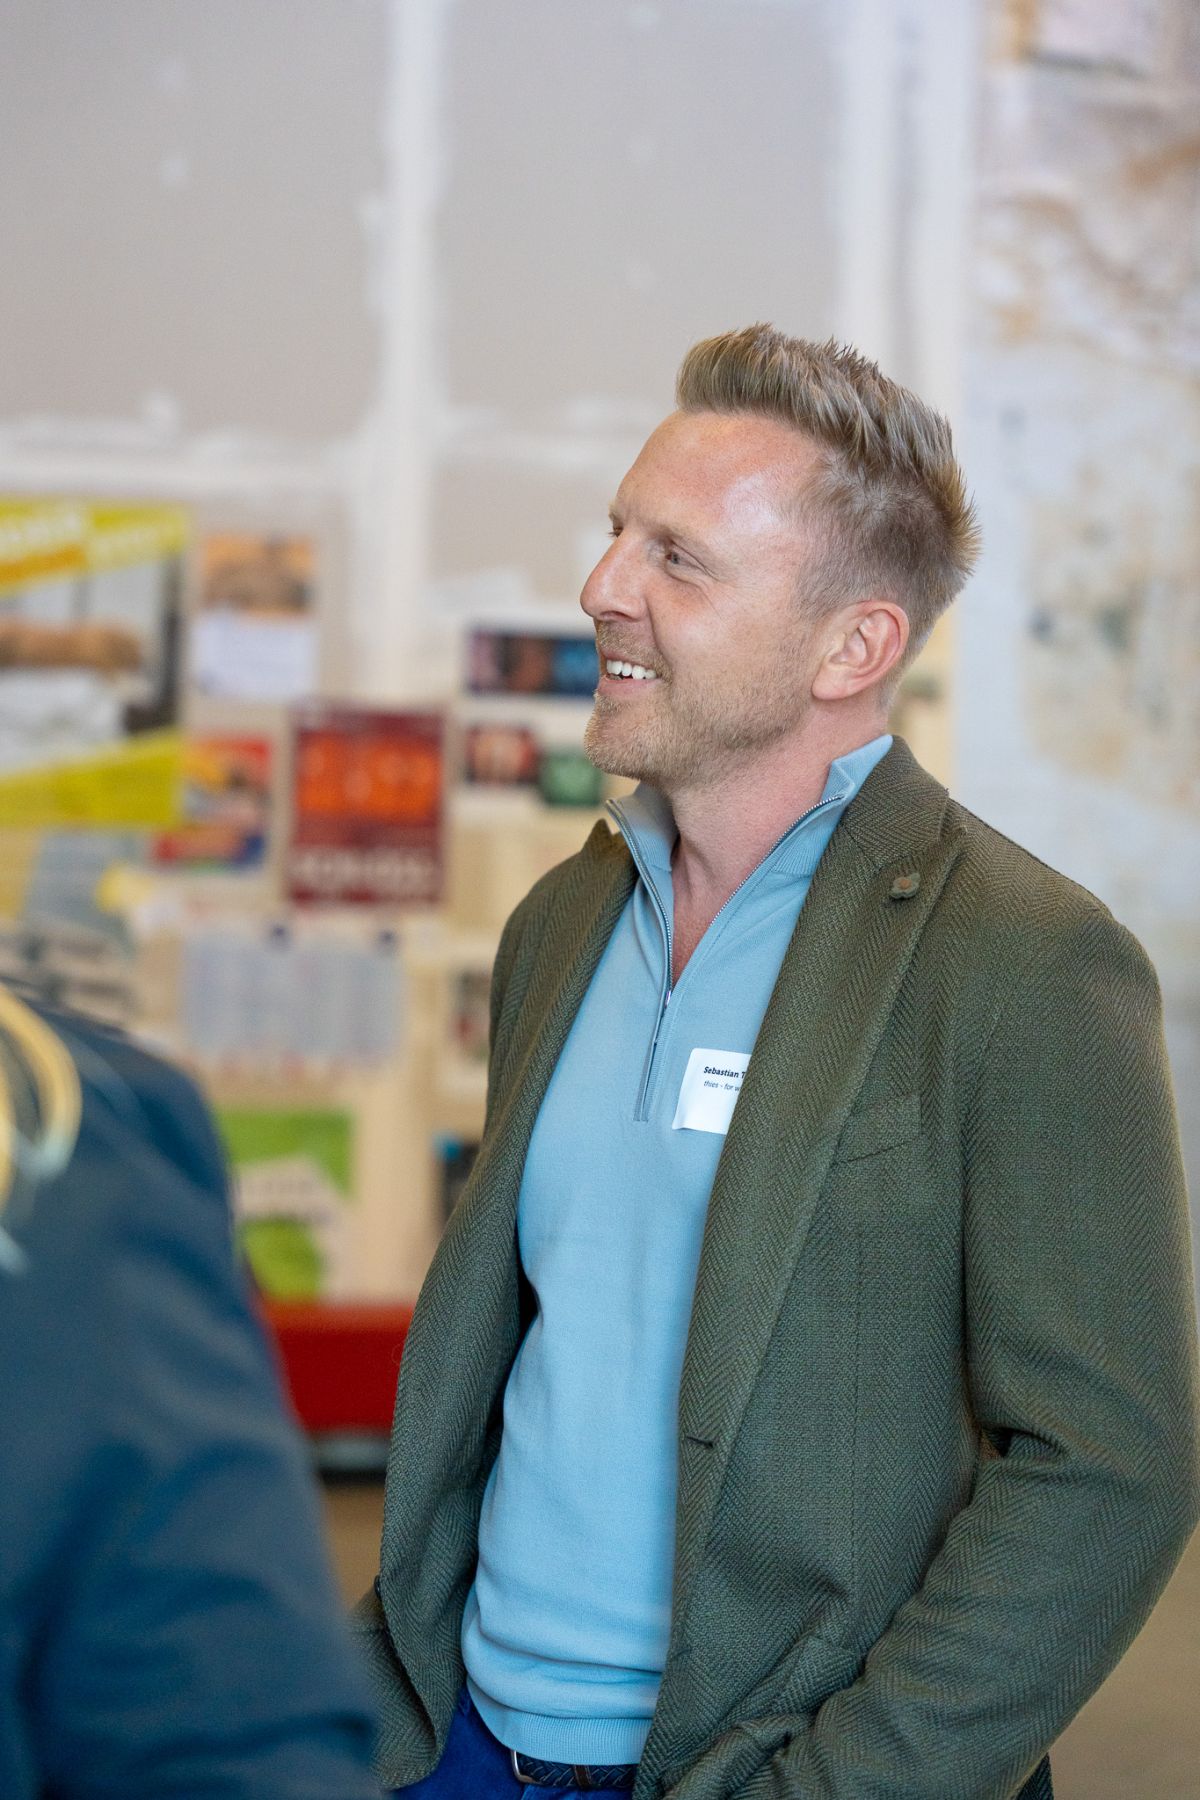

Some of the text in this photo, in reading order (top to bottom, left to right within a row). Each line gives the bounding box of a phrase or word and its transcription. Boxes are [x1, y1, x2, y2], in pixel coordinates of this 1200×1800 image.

[703, 1066, 739, 1078] Sebastian
[703, 1080, 719, 1089] thies
[724, 1082, 733, 1091] for
